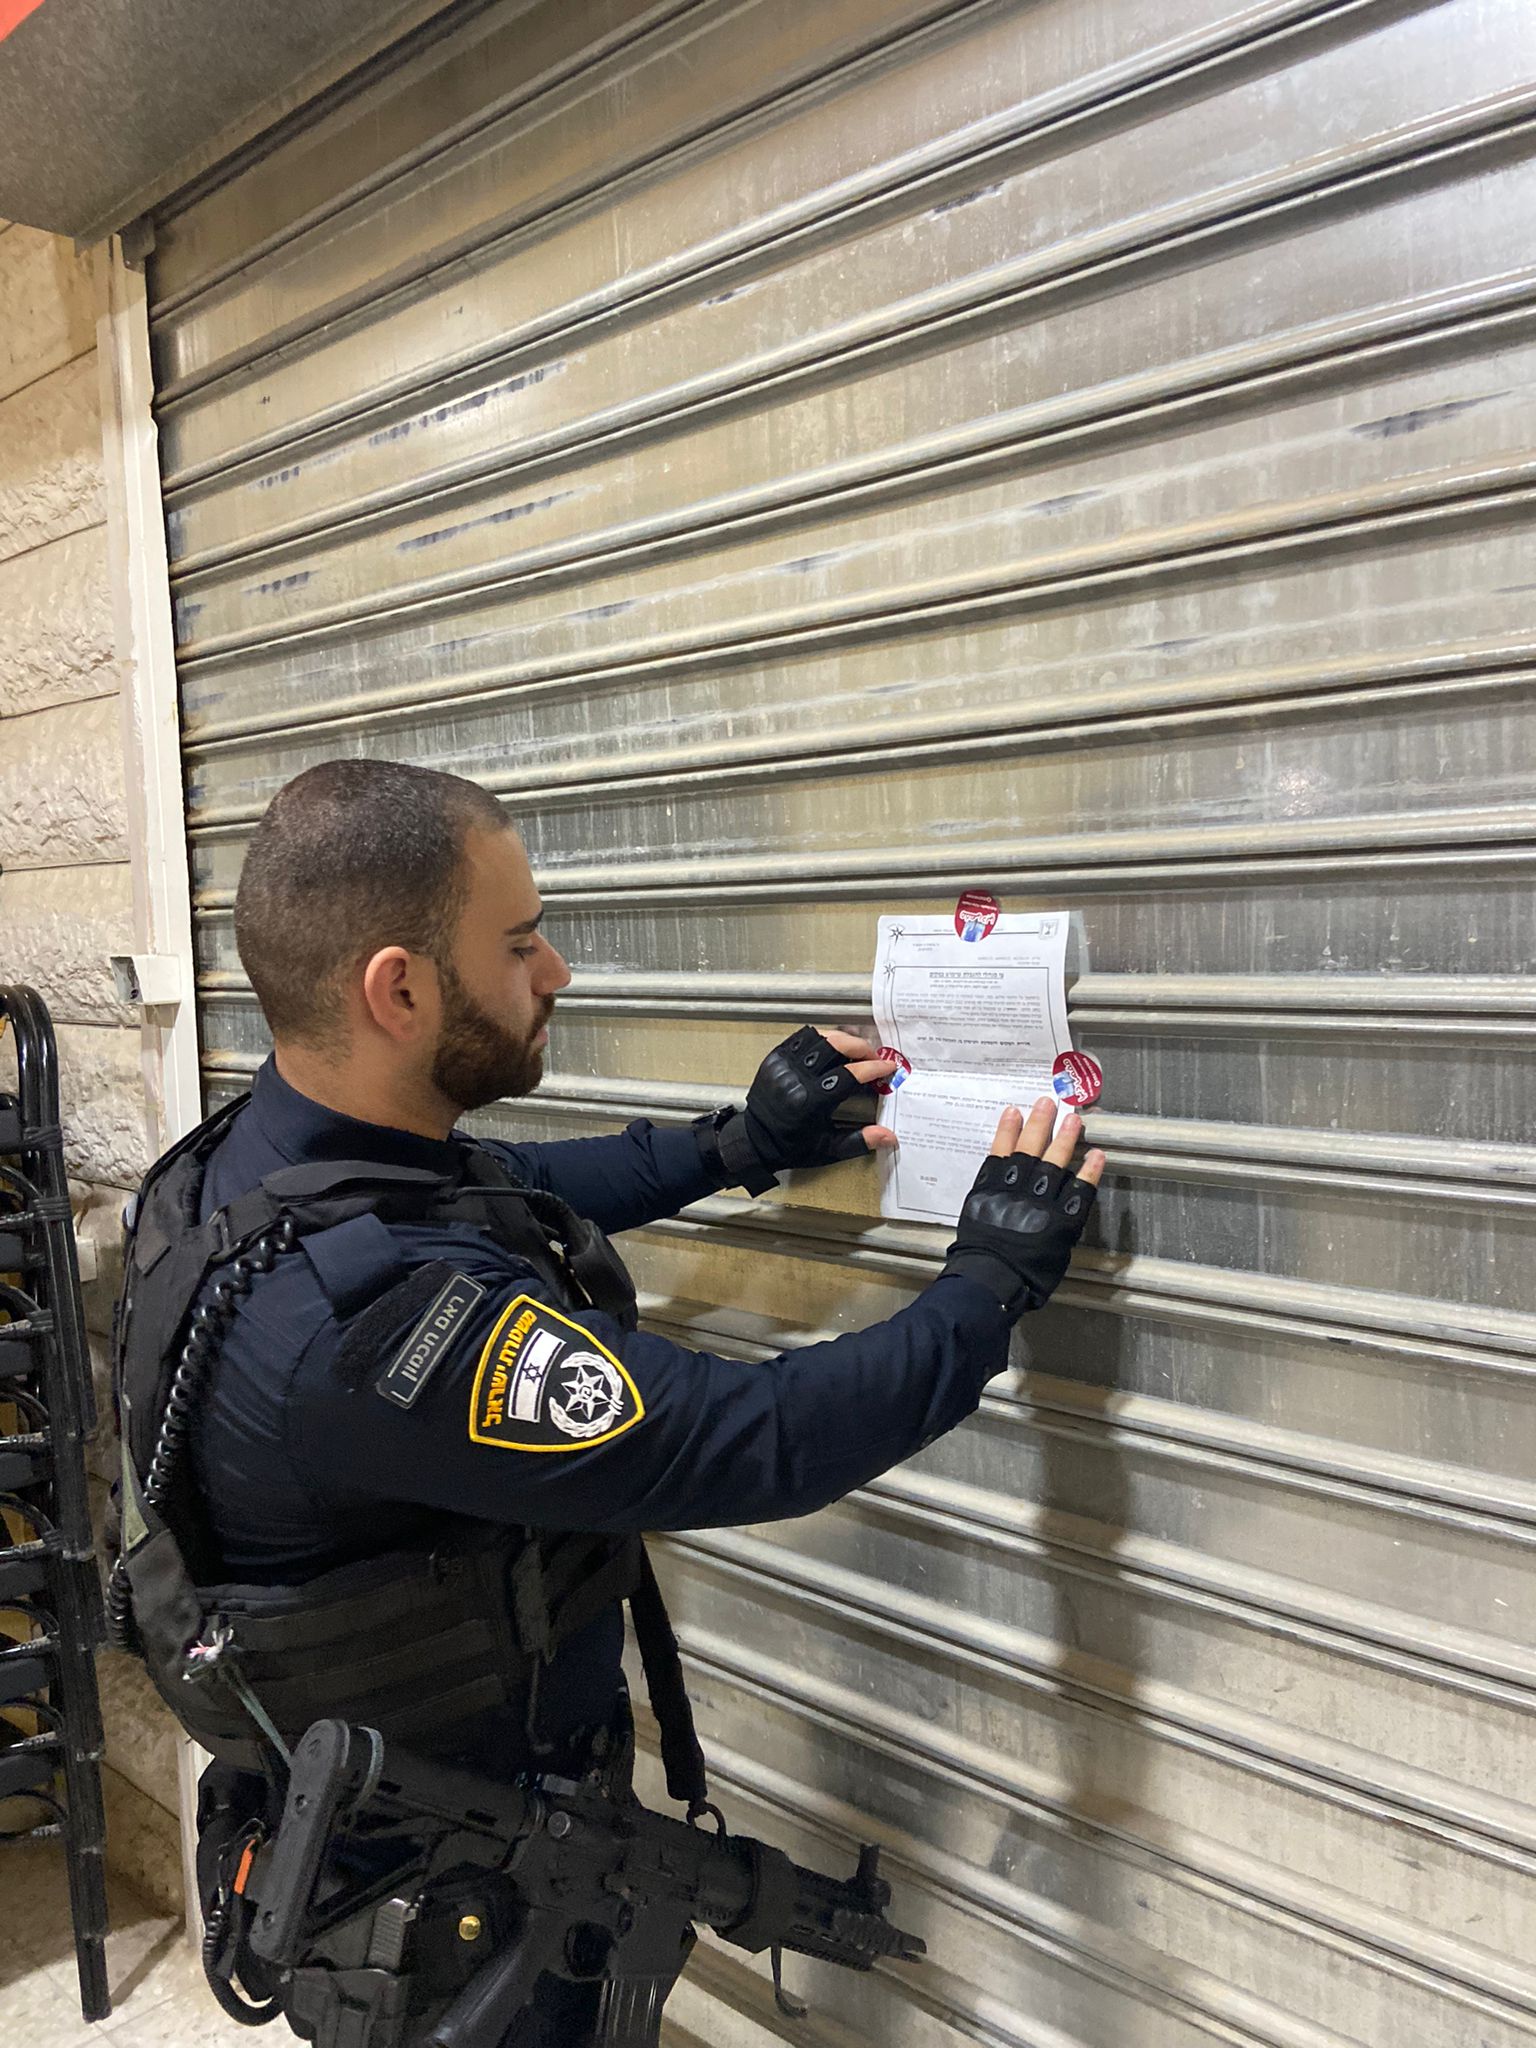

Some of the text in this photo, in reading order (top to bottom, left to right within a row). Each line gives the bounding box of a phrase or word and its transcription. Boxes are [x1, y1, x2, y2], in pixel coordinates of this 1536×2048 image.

[401, 1295, 465, 1382] ראם חכמון
[482, 1309, 537, 1428] משטרת ישראל
